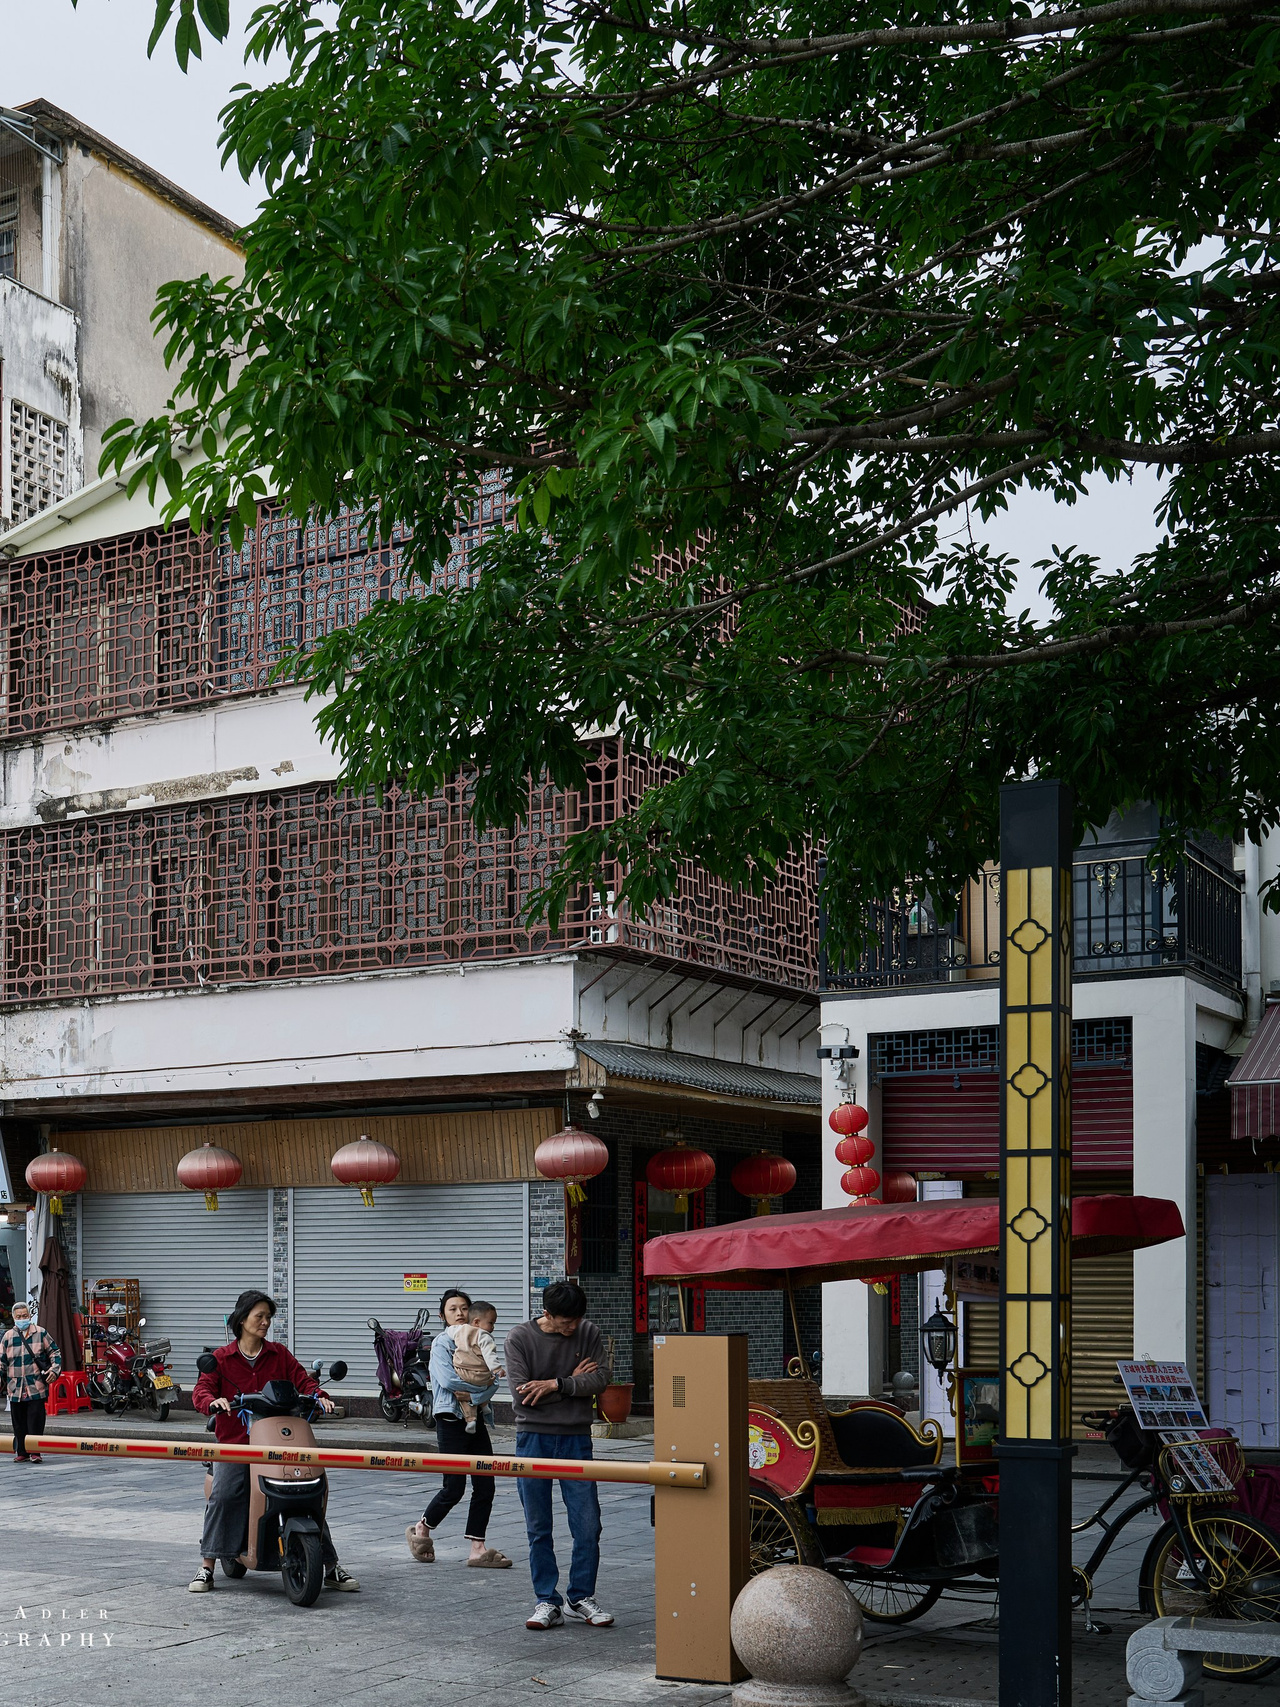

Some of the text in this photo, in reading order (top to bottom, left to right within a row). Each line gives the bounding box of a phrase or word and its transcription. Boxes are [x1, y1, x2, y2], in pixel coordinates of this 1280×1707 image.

[80, 1441, 108, 1452] BlueCard
[173, 1446, 203, 1457] BlueCard
[268, 1450, 299, 1462] BlueCard
[370, 1455, 403, 1467] BlueCard
[475, 1459, 511, 1472] BlueCard
